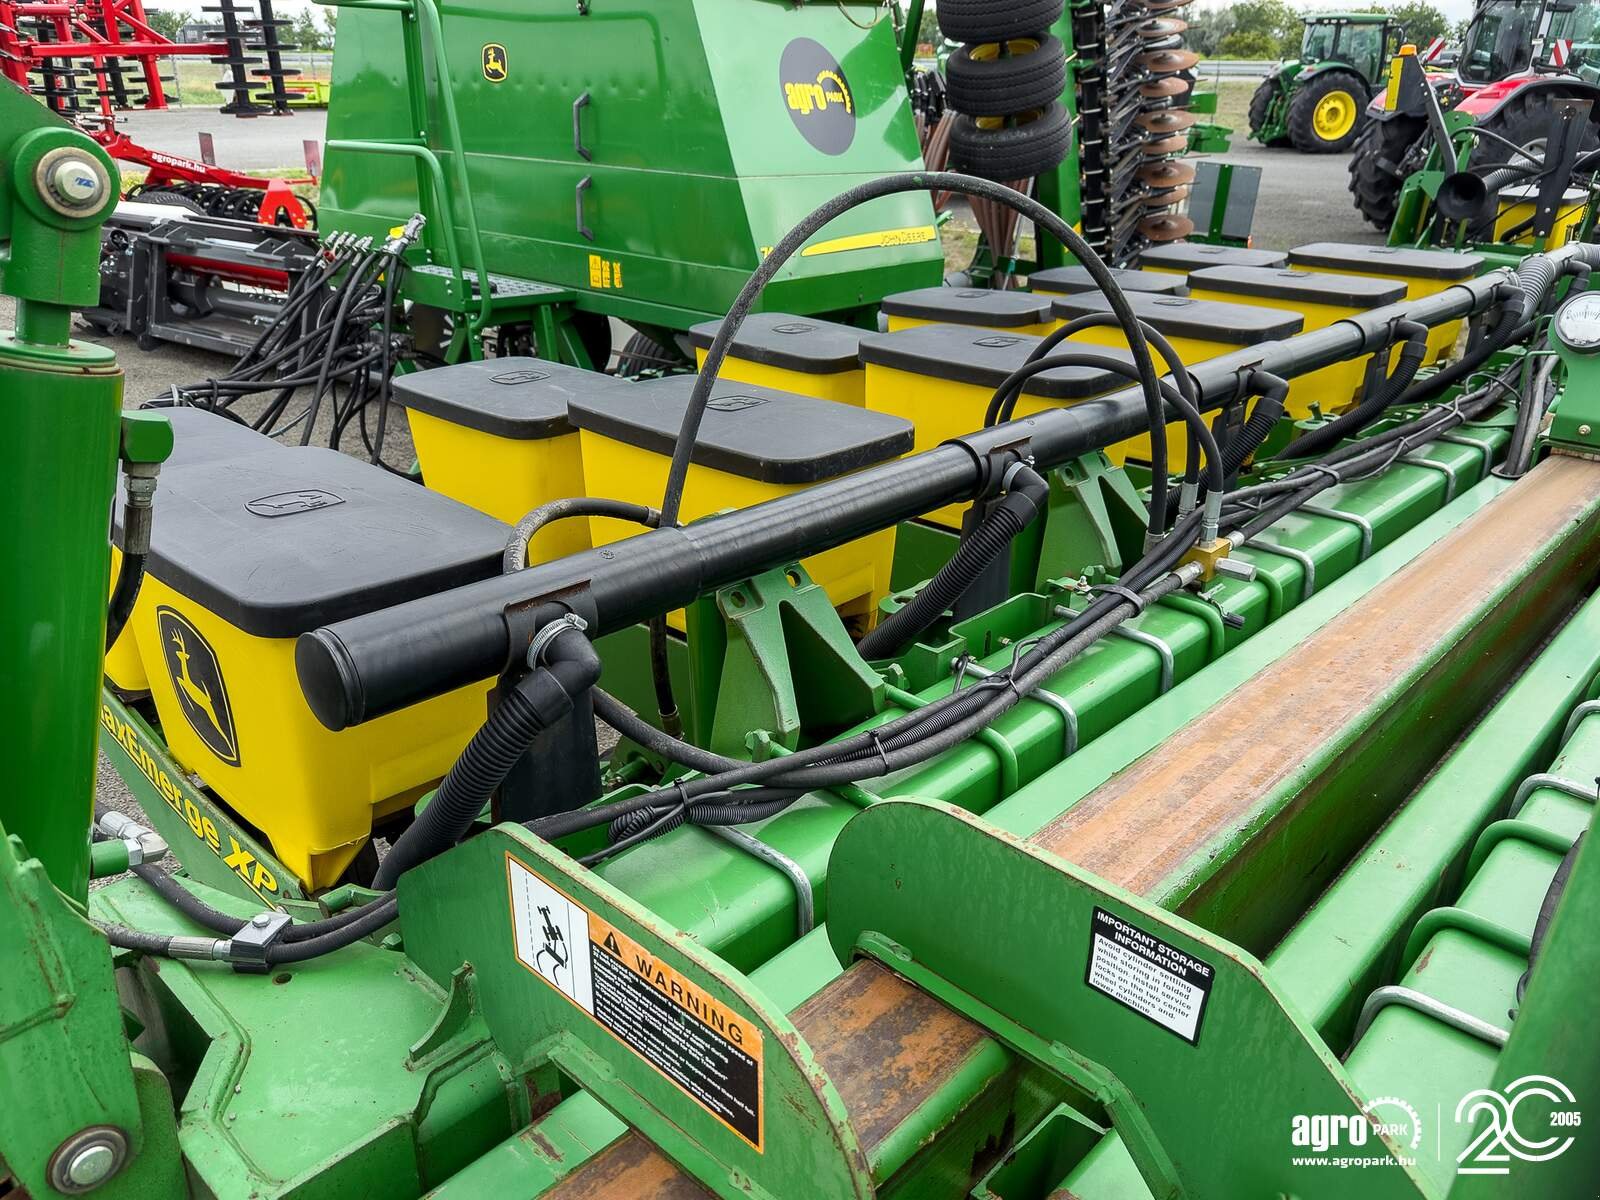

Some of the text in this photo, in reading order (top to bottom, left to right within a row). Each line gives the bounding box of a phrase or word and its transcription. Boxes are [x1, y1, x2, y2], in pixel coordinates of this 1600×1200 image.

[785, 83, 844, 114] agro PARK
[151, 152, 206, 173] agropark.hu
[881, 231, 927, 246] JOHN DEERE
[100, 704, 280, 894] axEmerge XP
[1097, 911, 1210, 977] IMPORTANT STORAGE
[1098, 937, 1192, 993] Avoid cylinder settling
[1114, 931, 1187, 976] INFORMATION
[1094, 970, 1116, 986] wheel
[1118, 983, 1155, 1009] cylinders
[1095, 962, 1189, 1018] locks on the two center
[1097, 945, 1189, 1000] while storing in folded
[1132, 974, 1158, 992] Install
[1161, 990, 1191, 1011] service
[636, 954, 742, 1046] WARNING
[1092, 977, 1152, 1016] lower machine.
